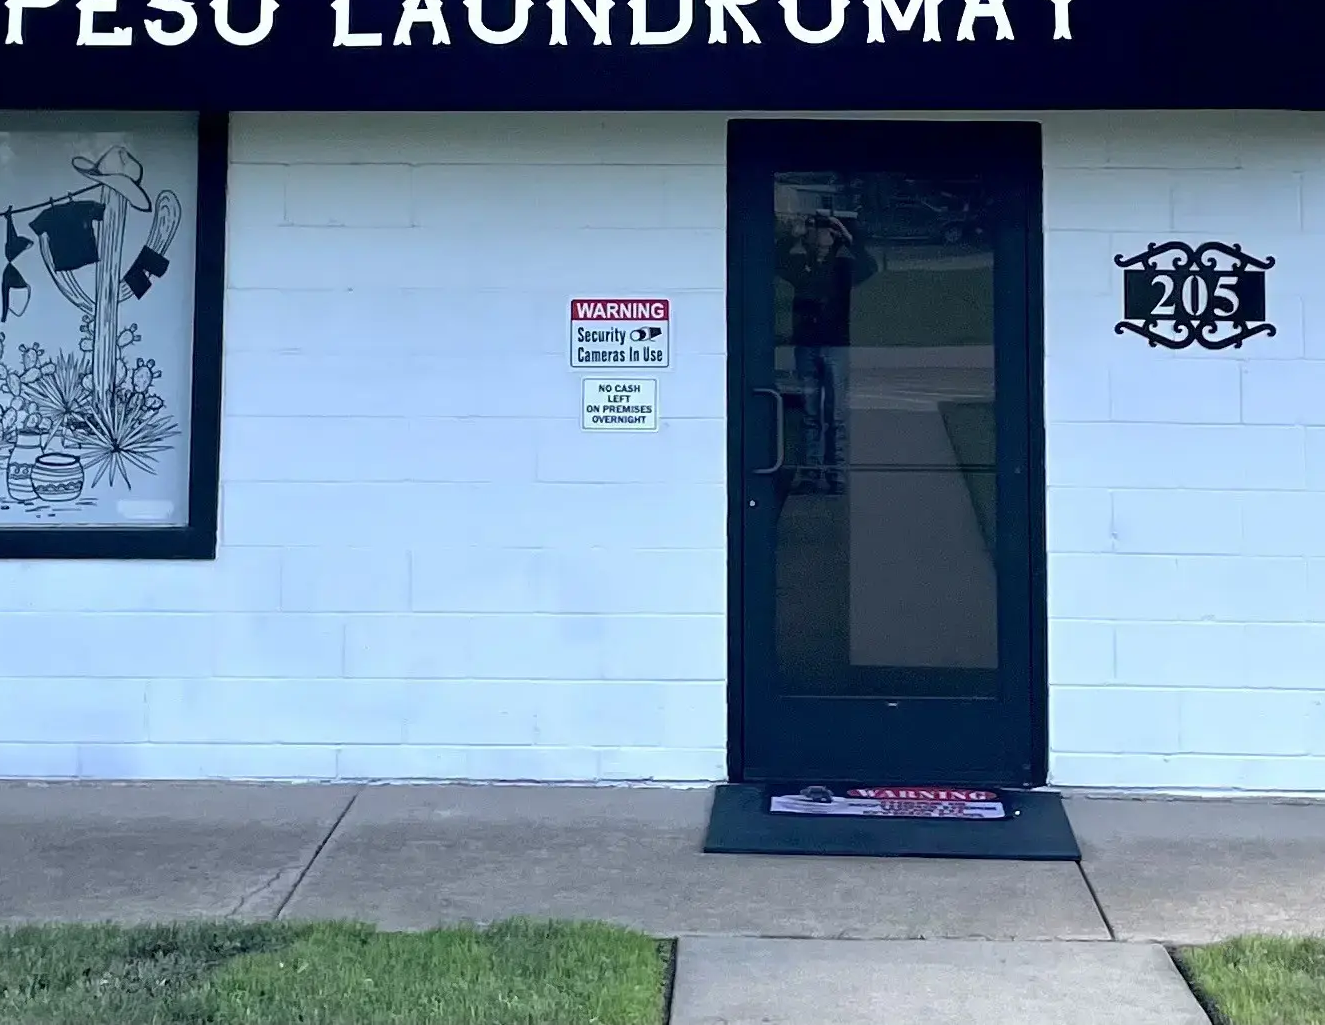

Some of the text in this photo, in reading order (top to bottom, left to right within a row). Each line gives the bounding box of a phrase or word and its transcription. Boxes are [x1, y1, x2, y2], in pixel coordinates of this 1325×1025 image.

[1150, 274, 1240, 317] 205
[576, 302, 665, 319] WARNING
[577, 326, 626, 345] Security
[577, 347, 663, 362] Cameras In Use
[598, 384, 641, 393] NO CASH
[607, 395, 631, 403] LEFT
[586, 405, 653, 414] ON PREMISES
[591, 415, 647, 424] OVERNIGHT
[856, 788, 987, 801] WARNING
